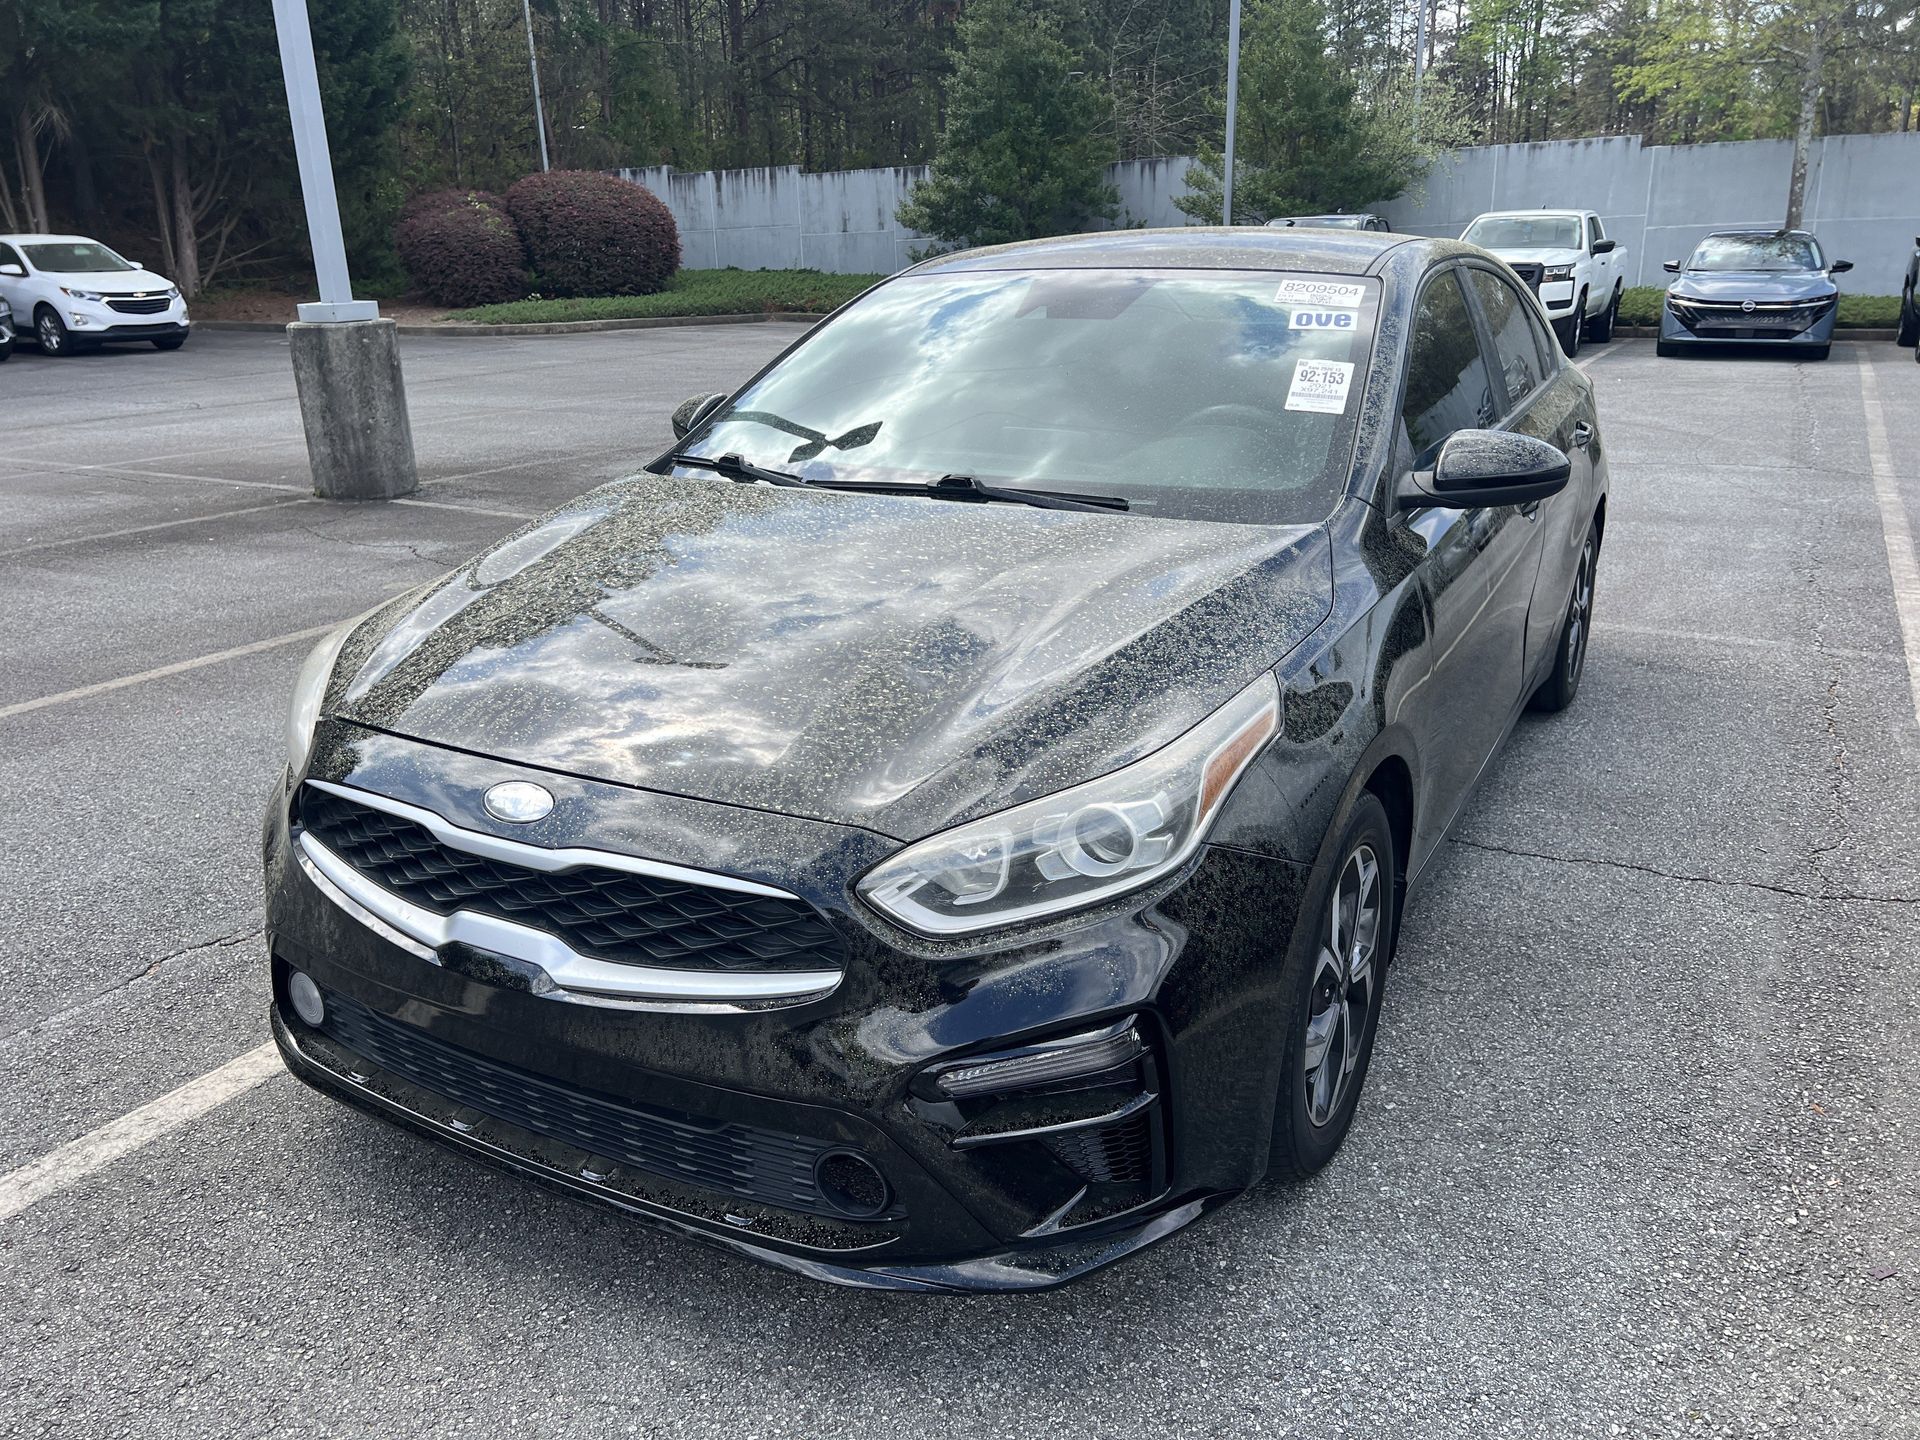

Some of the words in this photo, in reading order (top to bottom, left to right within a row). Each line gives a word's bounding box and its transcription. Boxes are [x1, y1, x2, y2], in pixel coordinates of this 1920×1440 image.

[1284, 282, 1359, 296] 8209504
[1295, 312, 1352, 327] ove
[1299, 369, 1345, 385] 92:153
